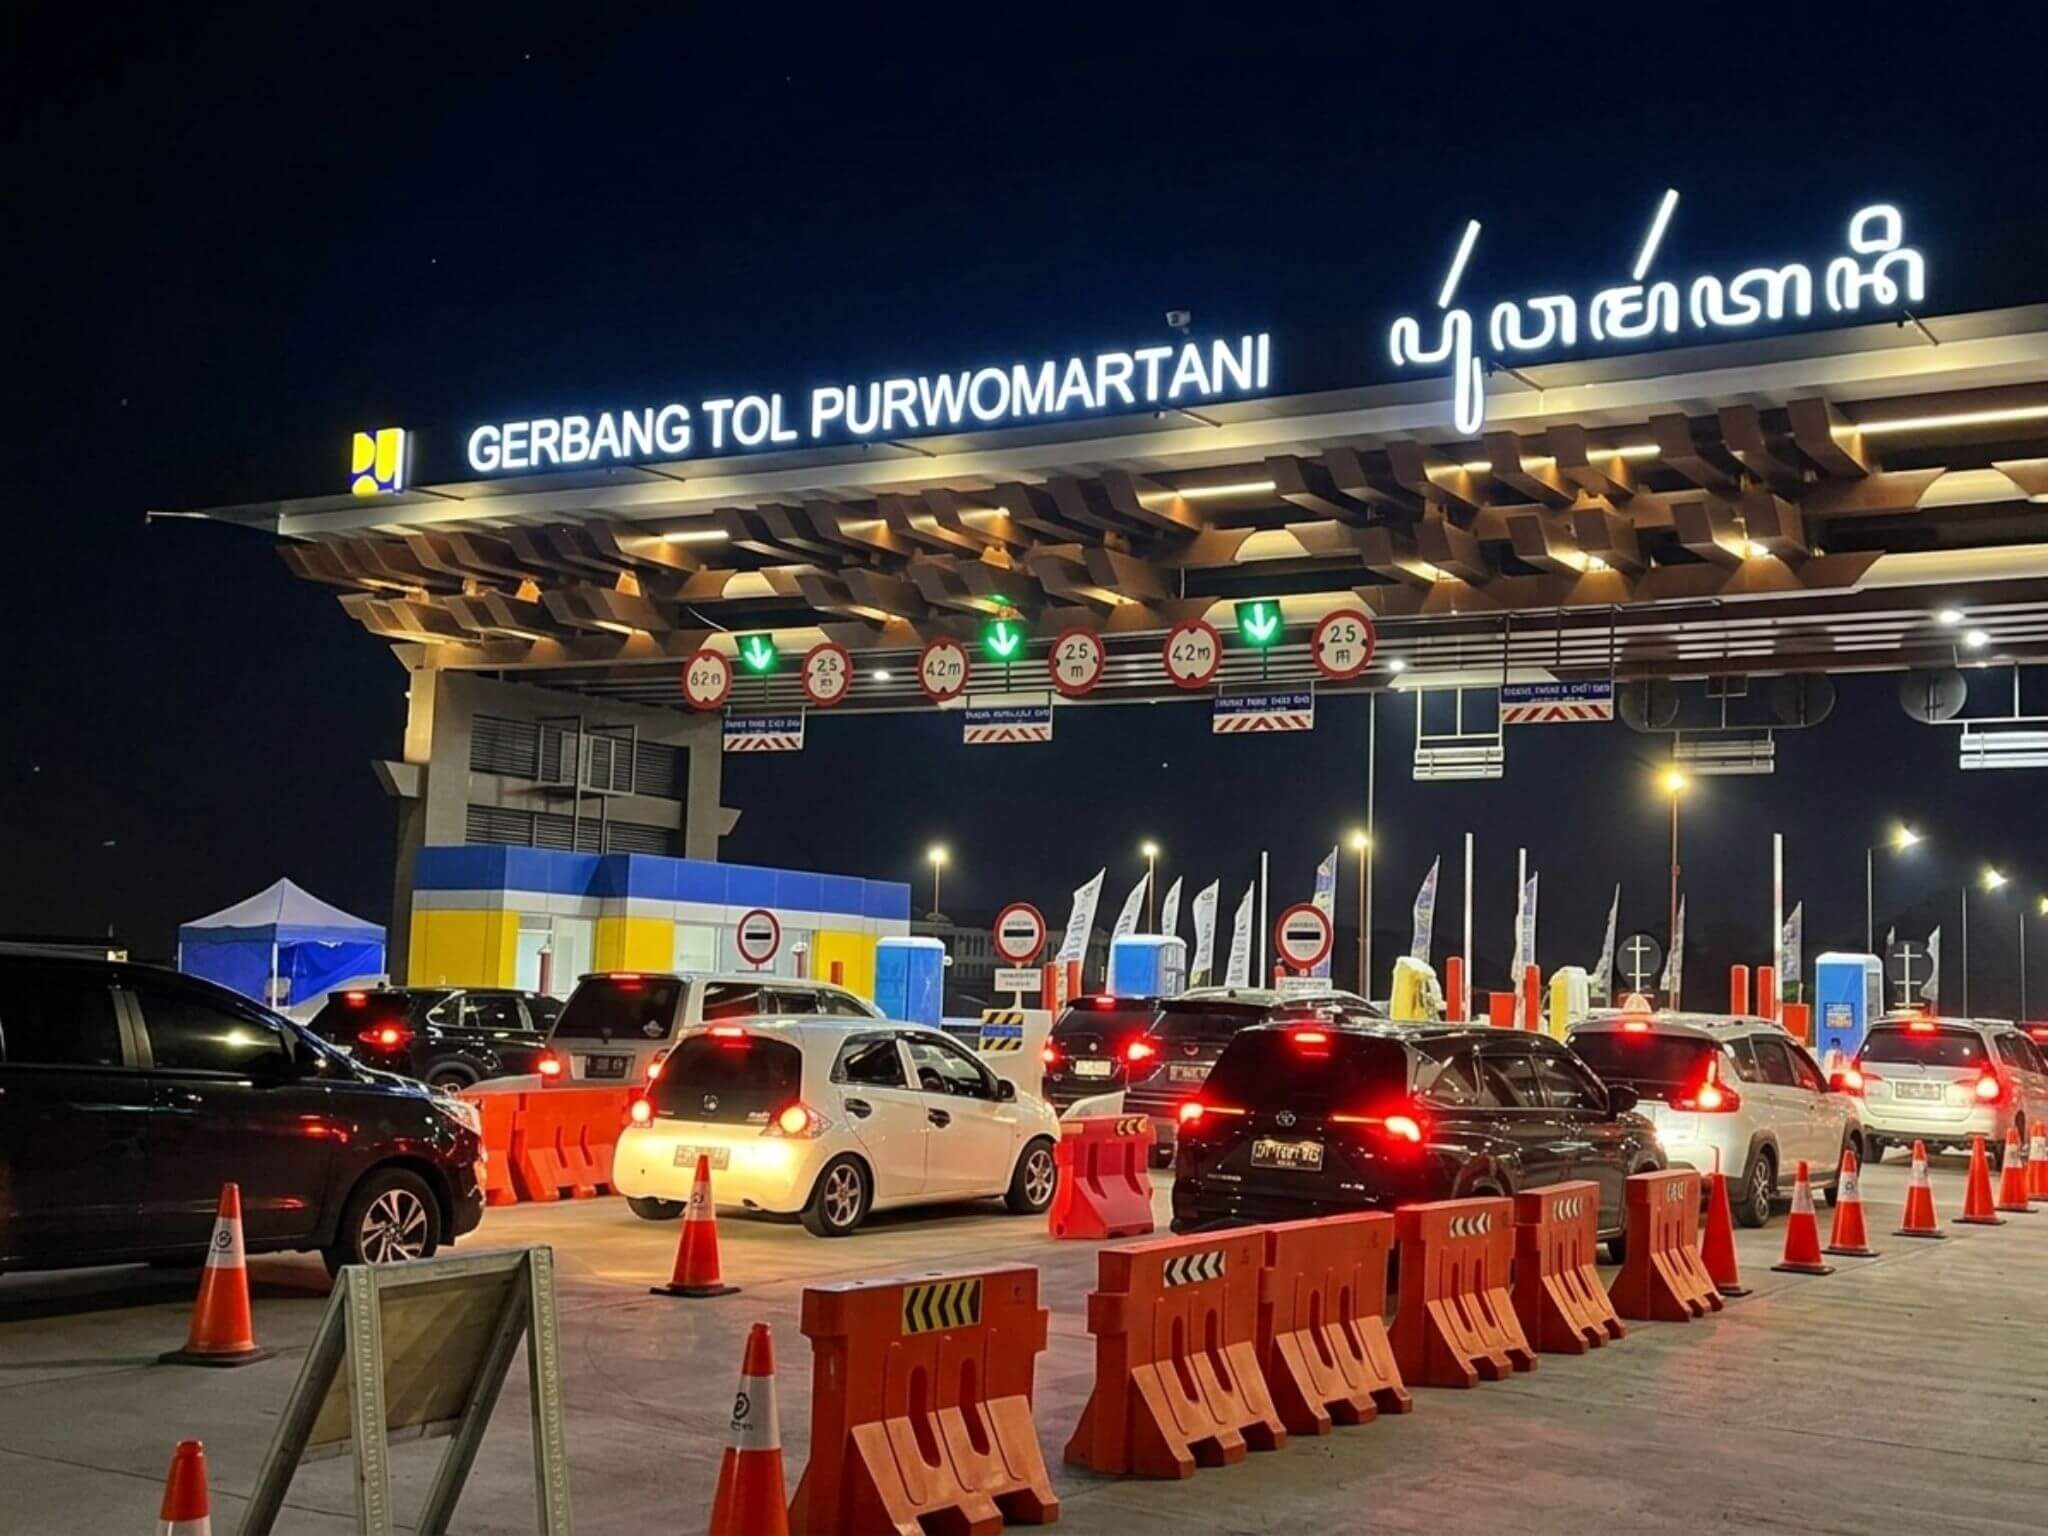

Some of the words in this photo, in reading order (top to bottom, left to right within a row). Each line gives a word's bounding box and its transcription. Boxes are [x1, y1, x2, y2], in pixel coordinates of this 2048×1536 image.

[467, 404, 693, 473] GERBANG
[702, 394, 797, 448] TOL
[811, 333, 1270, 439] PURWOMARTANI
